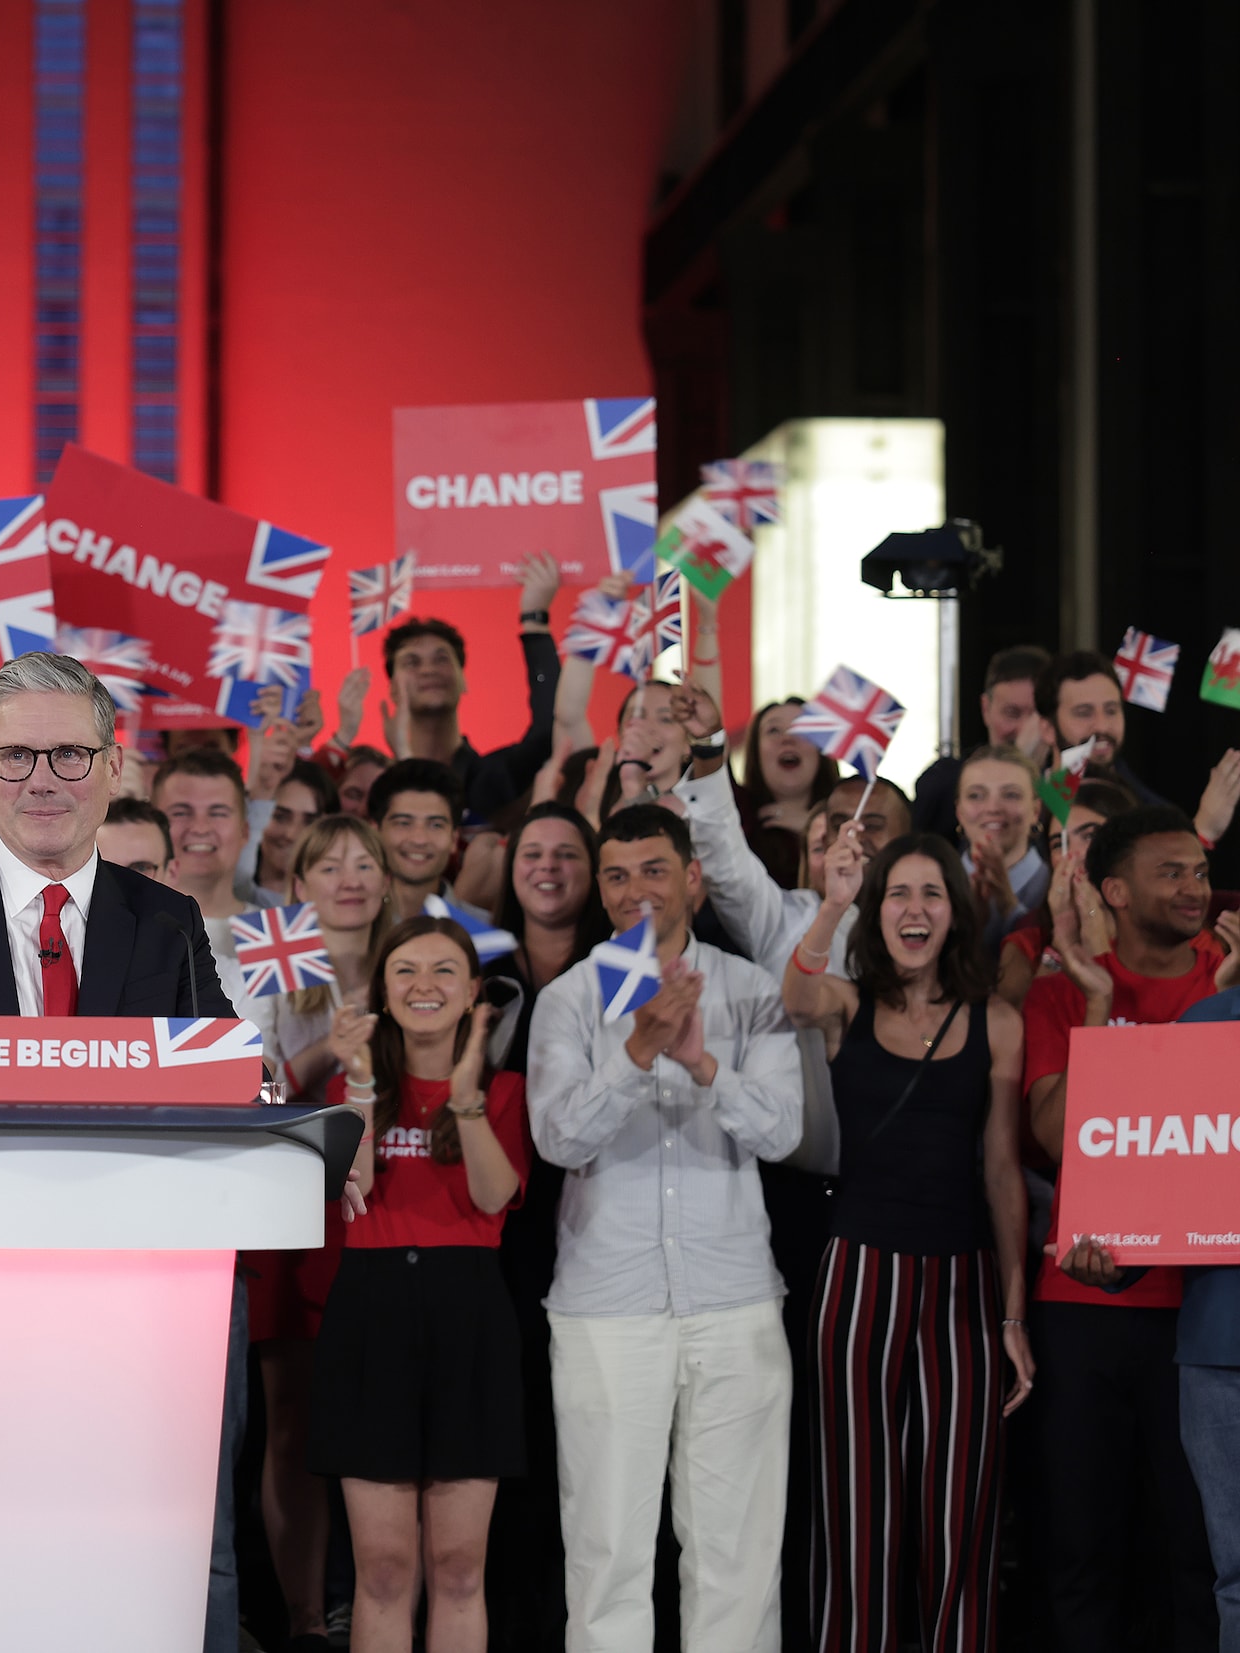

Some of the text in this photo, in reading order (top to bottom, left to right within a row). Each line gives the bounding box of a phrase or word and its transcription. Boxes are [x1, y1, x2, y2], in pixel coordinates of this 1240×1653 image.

[406, 470, 584, 509] CHANGE
[47, 518, 229, 620] CHANGE
[17, 1039, 151, 1069] BEGINS
[1078, 1114, 1240, 1158] CHAN
[1115, 1233, 1161, 1246] Labour
